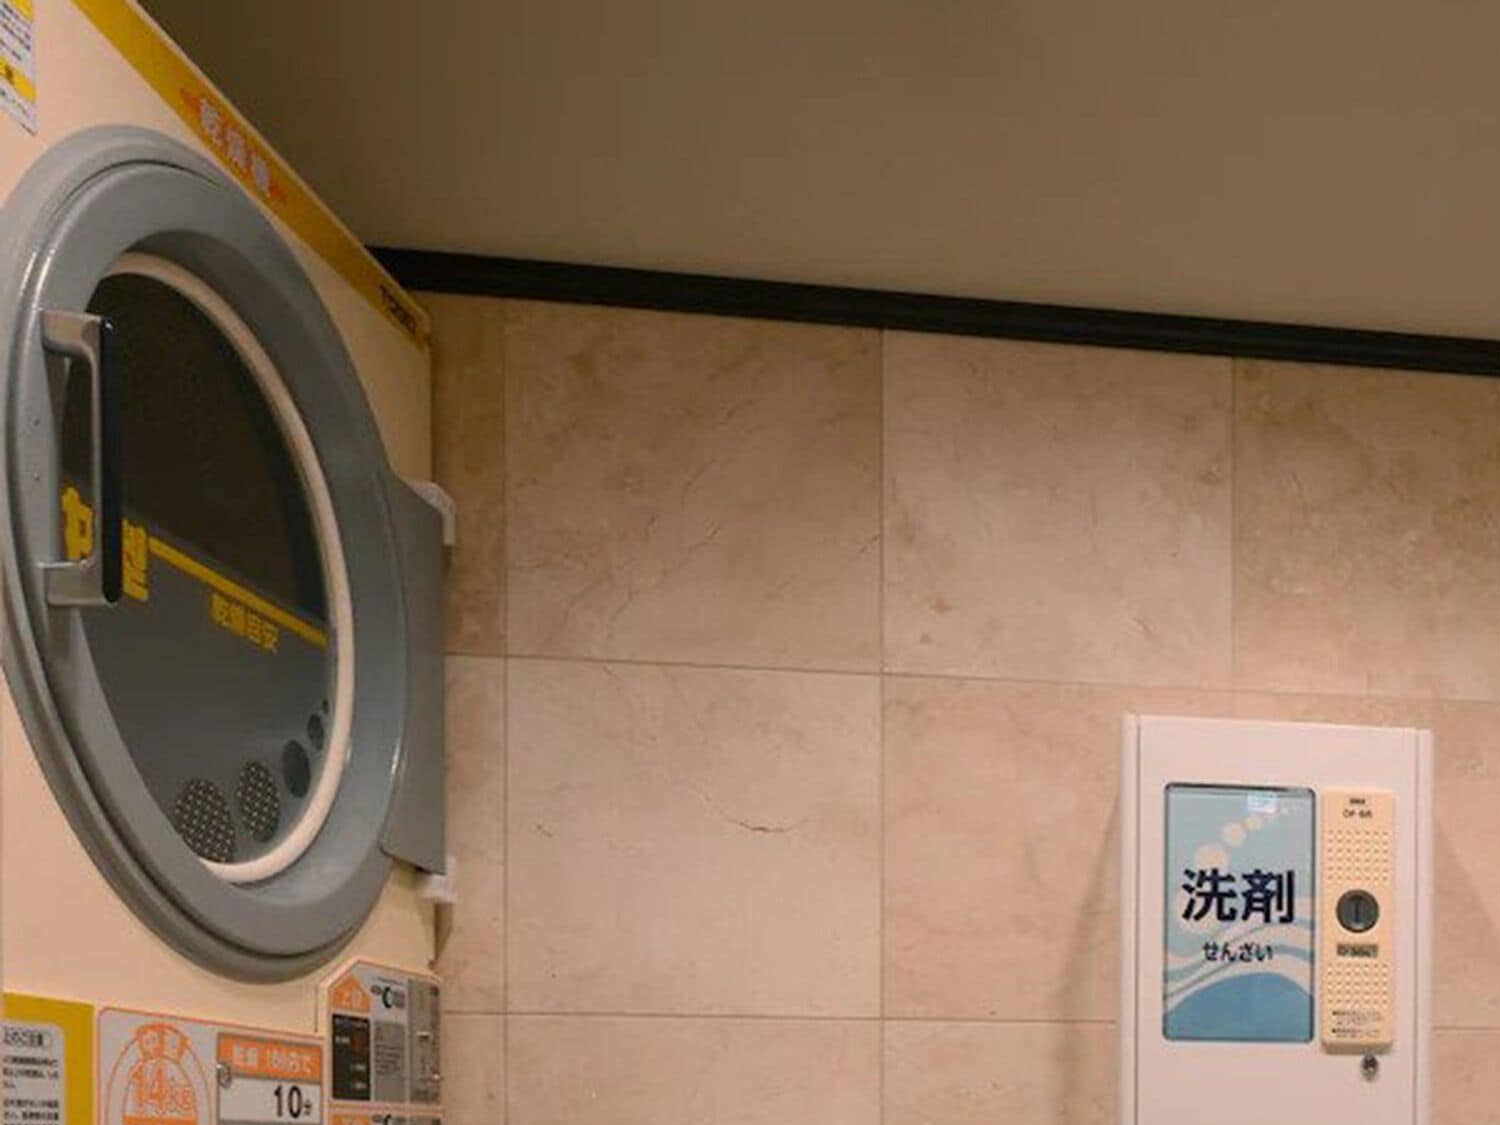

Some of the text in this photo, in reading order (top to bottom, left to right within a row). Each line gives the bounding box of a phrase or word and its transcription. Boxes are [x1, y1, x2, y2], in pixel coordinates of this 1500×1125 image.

[1181, 868, 1296, 923] 洗剤
[1202, 941, 1274, 963] せんざい
